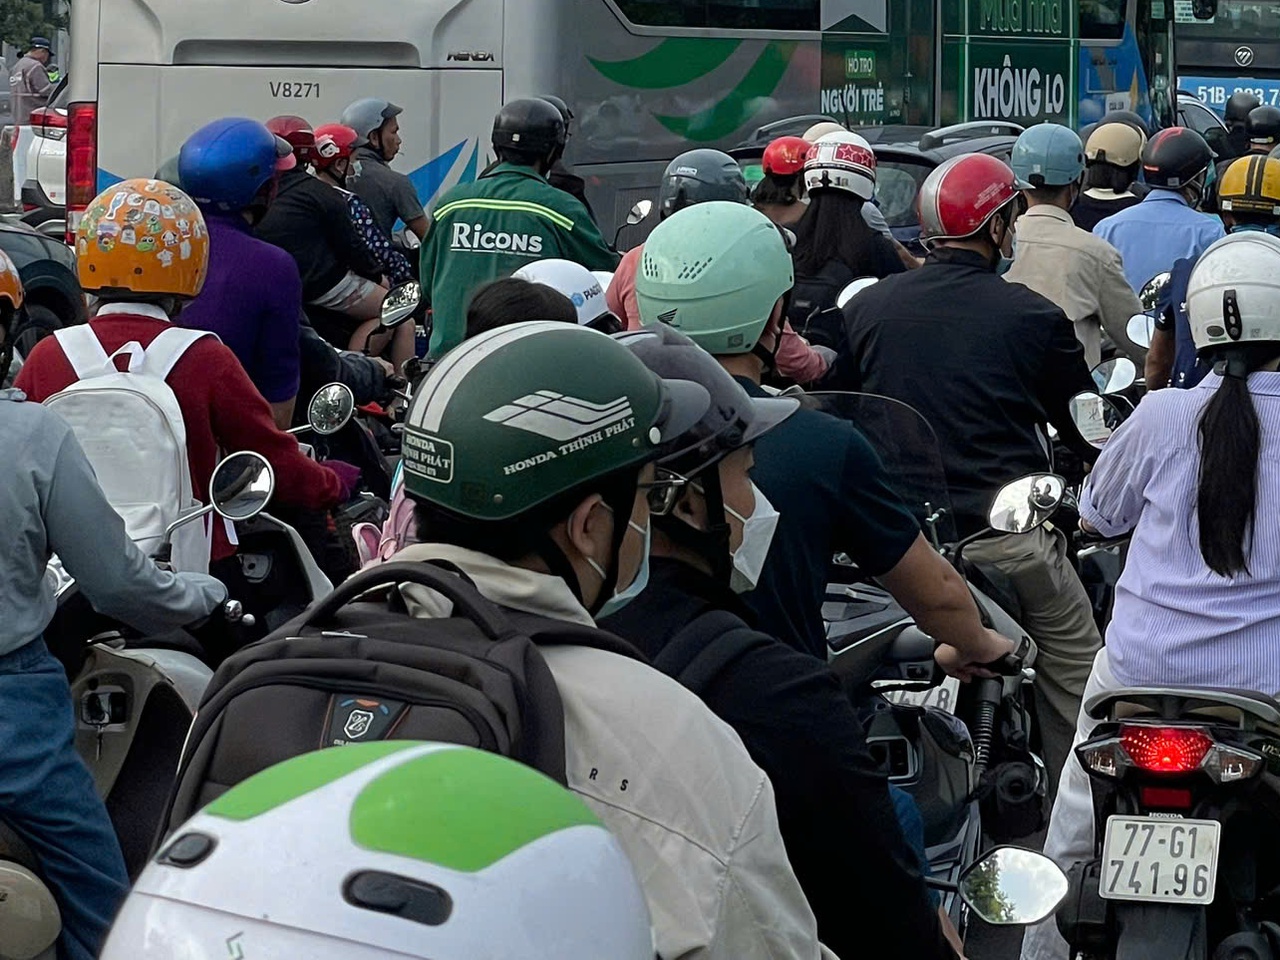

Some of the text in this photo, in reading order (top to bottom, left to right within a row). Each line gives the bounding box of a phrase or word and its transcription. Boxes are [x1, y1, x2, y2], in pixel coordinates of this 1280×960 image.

[269, 81, 321, 99] V8271
[821, 83, 860, 114] NGƯỜI
[861, 80, 884, 113] TRẺ
[974, 54, 1065, 118] KHÔNG LO
[406, 433, 436, 453] HONDA
[504, 417, 636, 476] HONDA THỊNH PHÁT
[420, 452, 451, 469] PHÁT
[588, 767, 629, 792] R S
[1148, 812, 1184, 820] HONDA
[1122, 823, 1198, 859] 77-G1
[1108, 860, 1209, 898] 741.96
